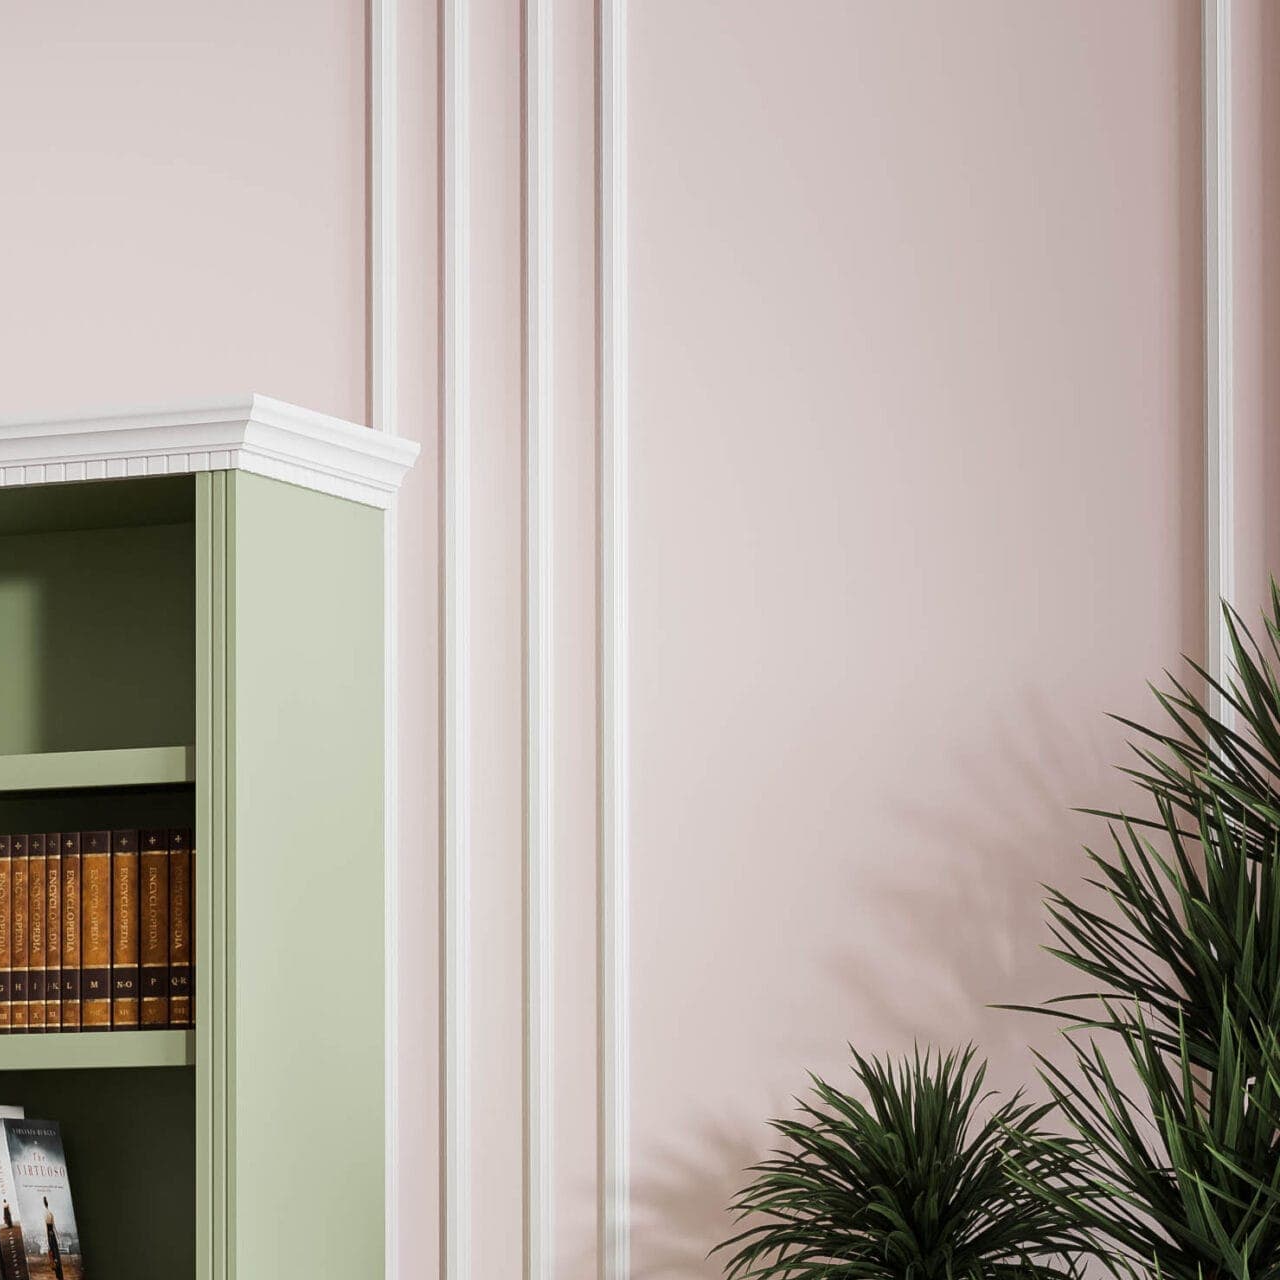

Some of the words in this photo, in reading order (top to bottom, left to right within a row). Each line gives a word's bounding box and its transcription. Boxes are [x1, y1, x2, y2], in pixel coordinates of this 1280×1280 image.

[66, 870, 75, 952] ENCYCLOPEDIA
[120, 867, 128, 950] ENCYCLOPEDIA
[149, 867, 157, 949] ENCYCLOPEDIA
[16, 1164, 65, 1177] VIRTUOSO
